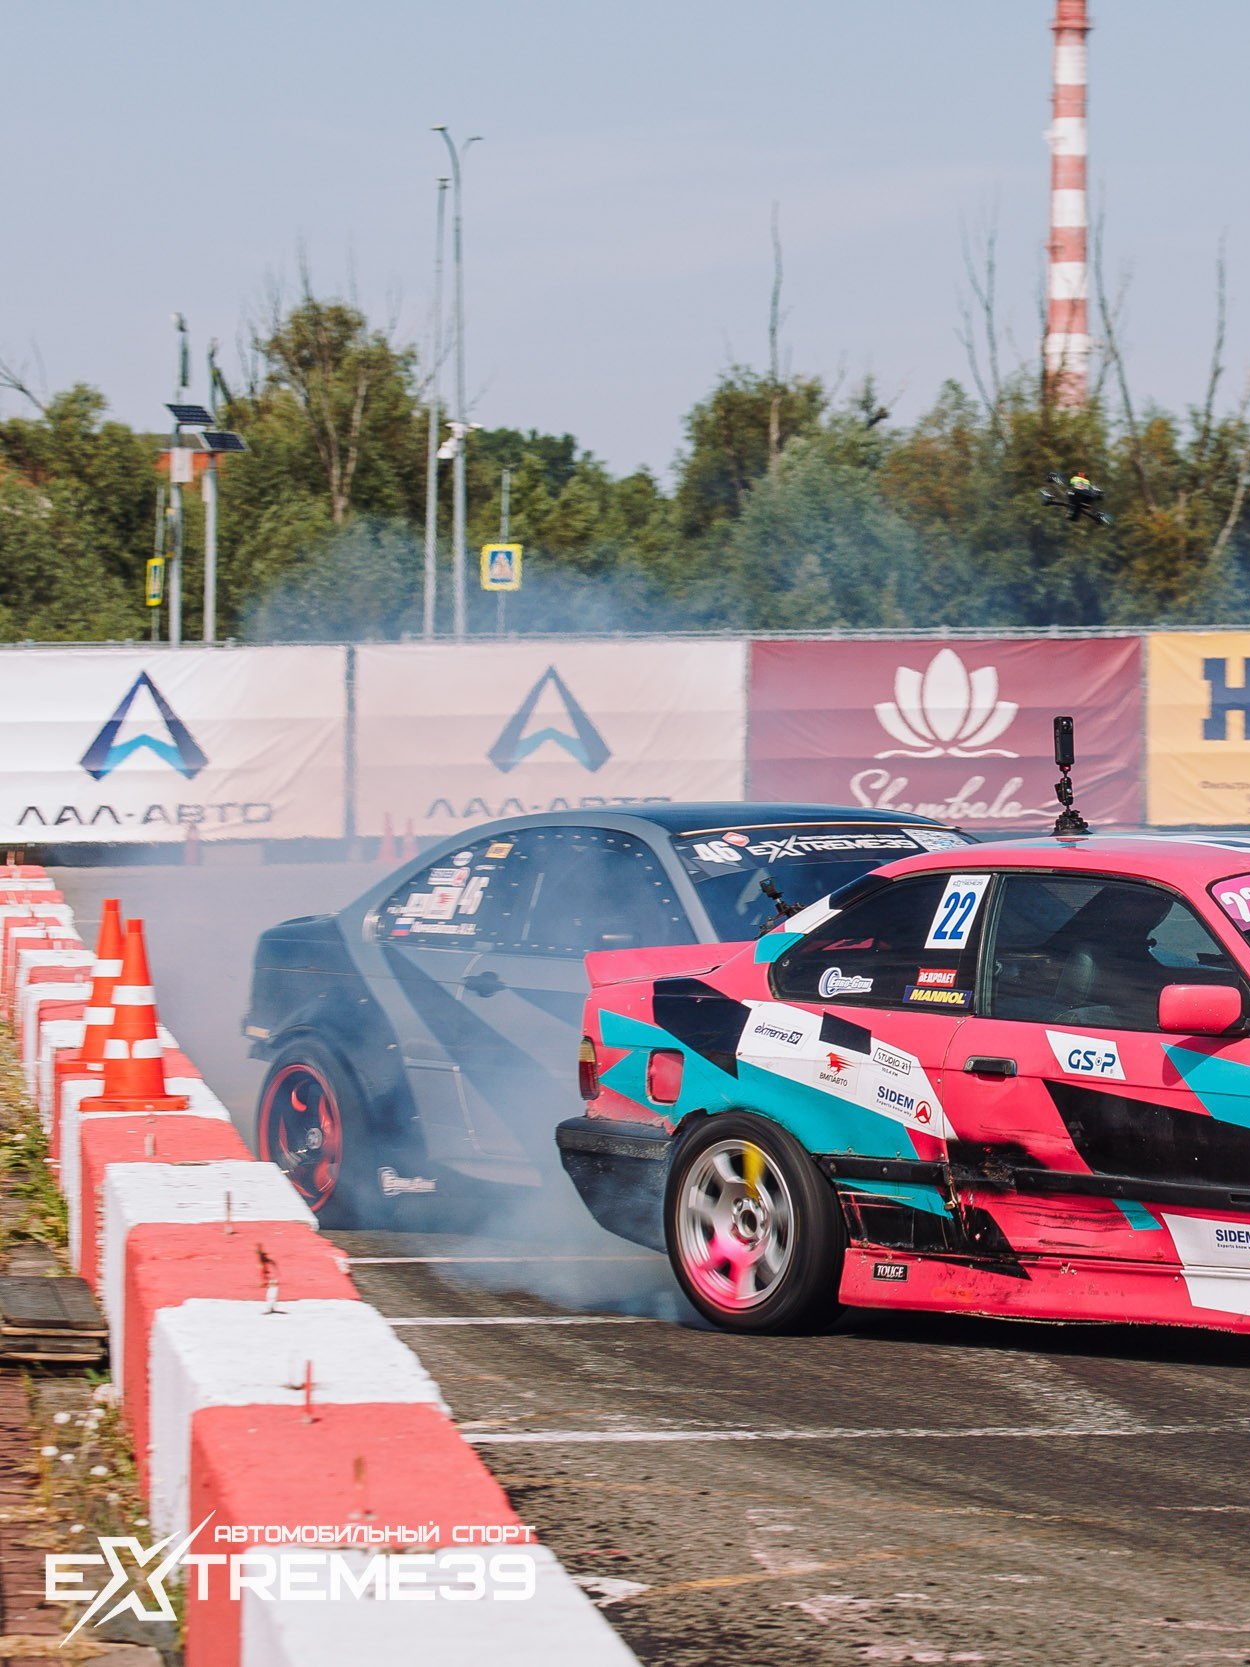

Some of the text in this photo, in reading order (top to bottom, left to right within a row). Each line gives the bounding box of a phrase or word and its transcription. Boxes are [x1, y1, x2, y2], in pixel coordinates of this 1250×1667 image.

[692, 842, 743, 863] 46
[932, 891, 977, 940] 22
[910, 989, 966, 1004] MANNOL
[878, 1052, 900, 1067] STUDIO
[819, 1072, 848, 1088] ВМПАВТО
[877, 1085, 914, 1110] SIDEM
